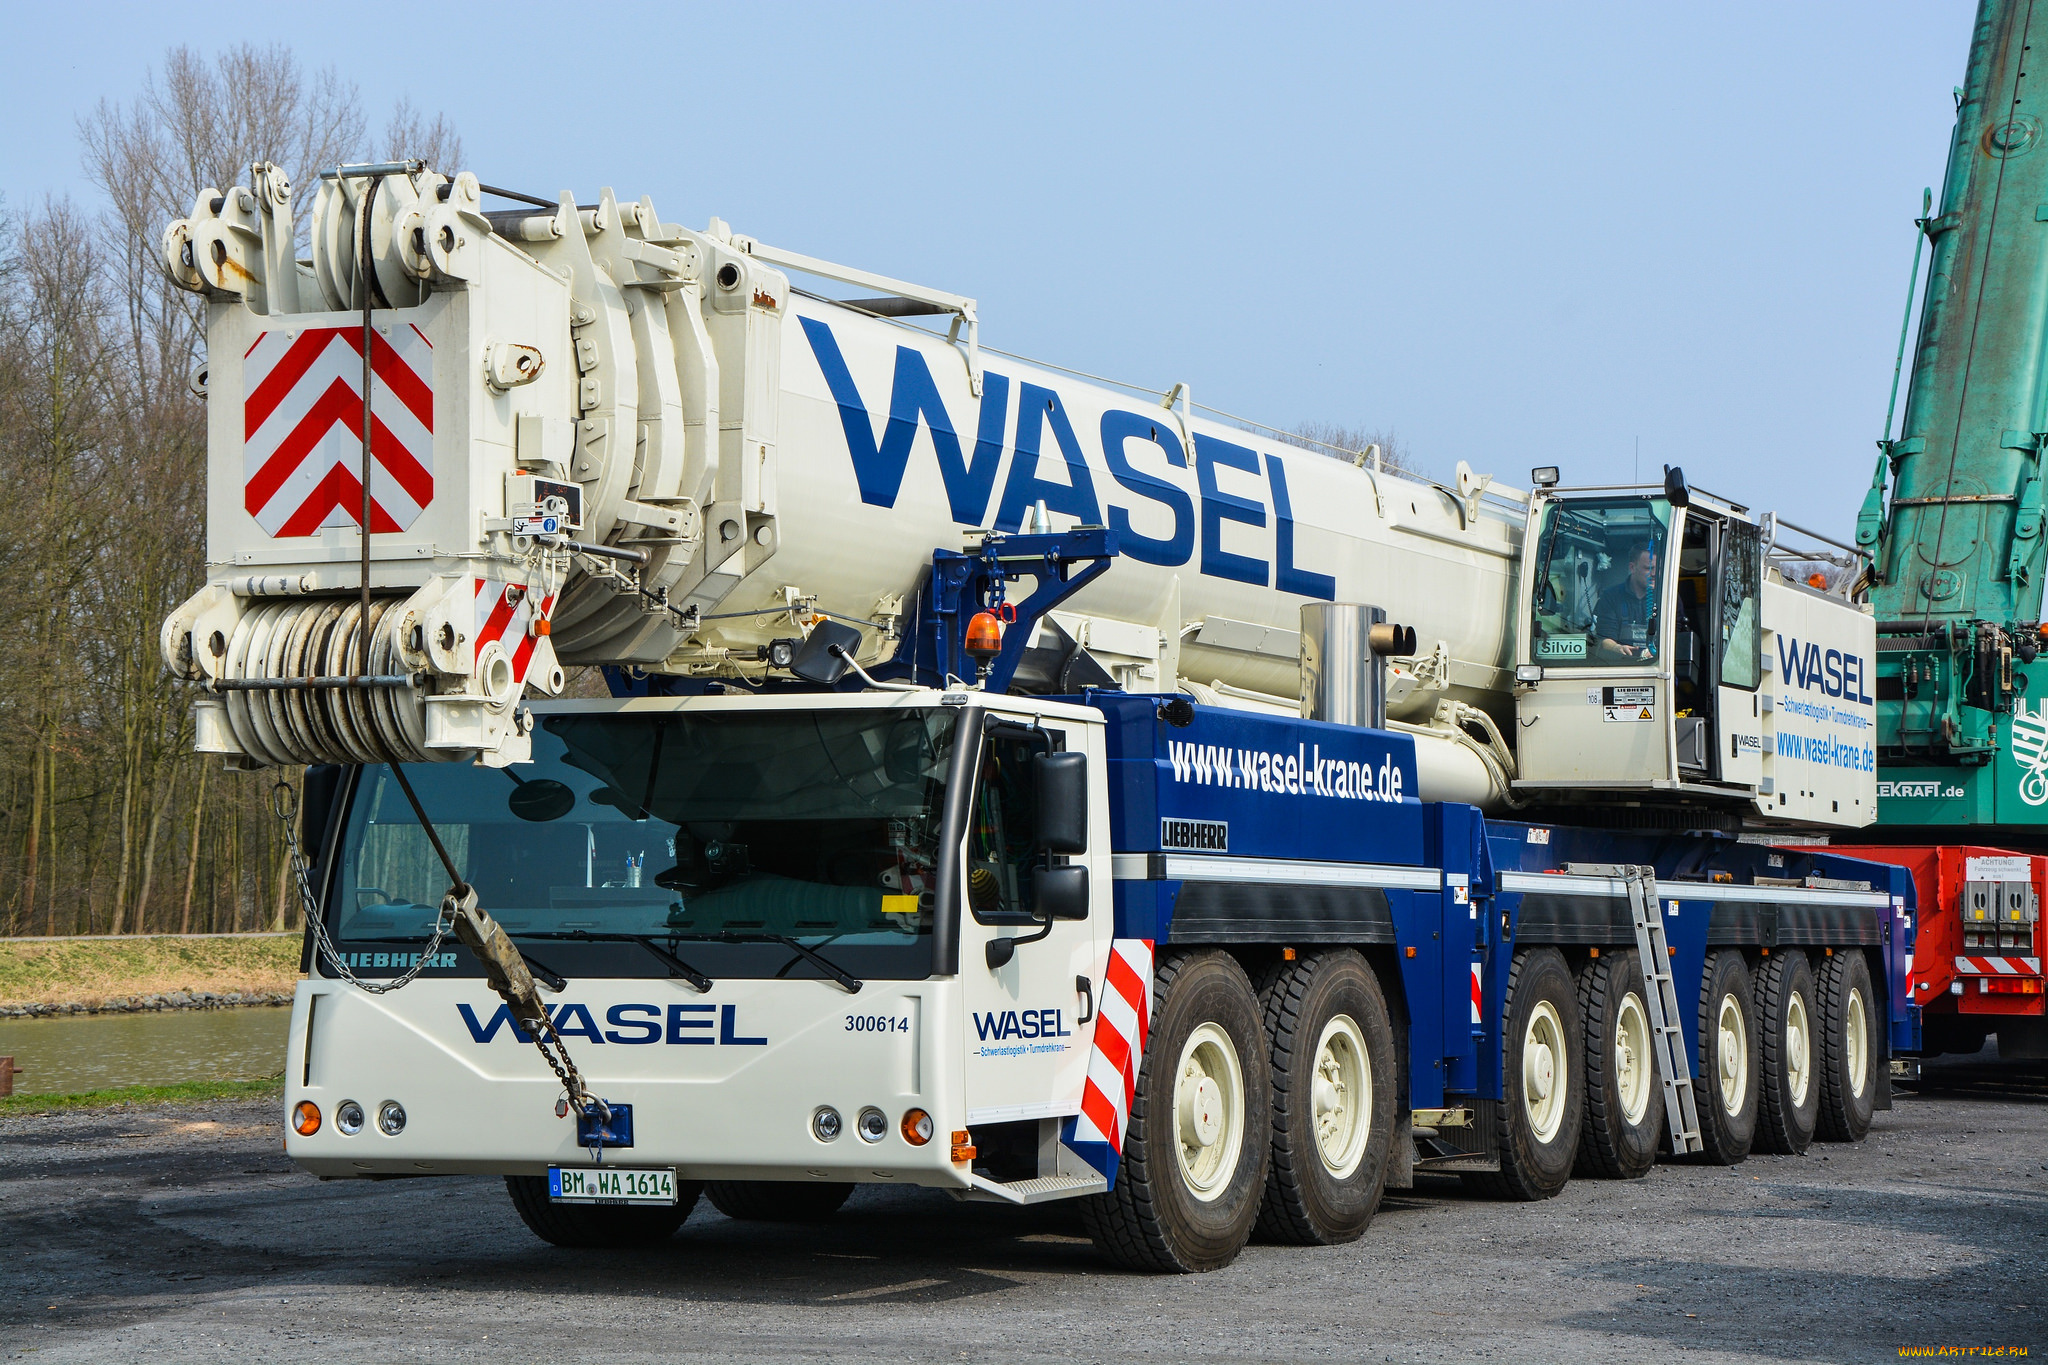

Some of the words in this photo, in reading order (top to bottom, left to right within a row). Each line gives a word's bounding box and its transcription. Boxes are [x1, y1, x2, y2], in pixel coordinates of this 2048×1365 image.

[796, 314, 1336, 602] WASEL
[1541, 641, 1583, 654] Silvio
[1776, 633, 1873, 706] WASEL
[1738, 734, 1762, 748] WASEL
[1776, 731, 1874, 773] www.wasel-krane.de
[1168, 740, 1403, 804] www.wasel-krane.de
[1877, 781, 1965, 797] EKRAFT.de
[1162, 820, 1227, 850] LIEBHERR
[339, 952, 457, 968] LIEBHERR
[456, 1004, 768, 1046] WASEL
[845, 1015, 909, 1033] 300614
[972, 1009, 1071, 1041] WASEL
[980, 1046, 1027, 1058] Schwerlastlogistik
[1029, 1042, 1065, 1054] Turmdrehkrane
[553, 1184, 558, 1192] D
[561, 1171, 585, 1194] BM
[598, 1172, 621, 1195] WA
[626, 1173, 672, 1195] 1614
